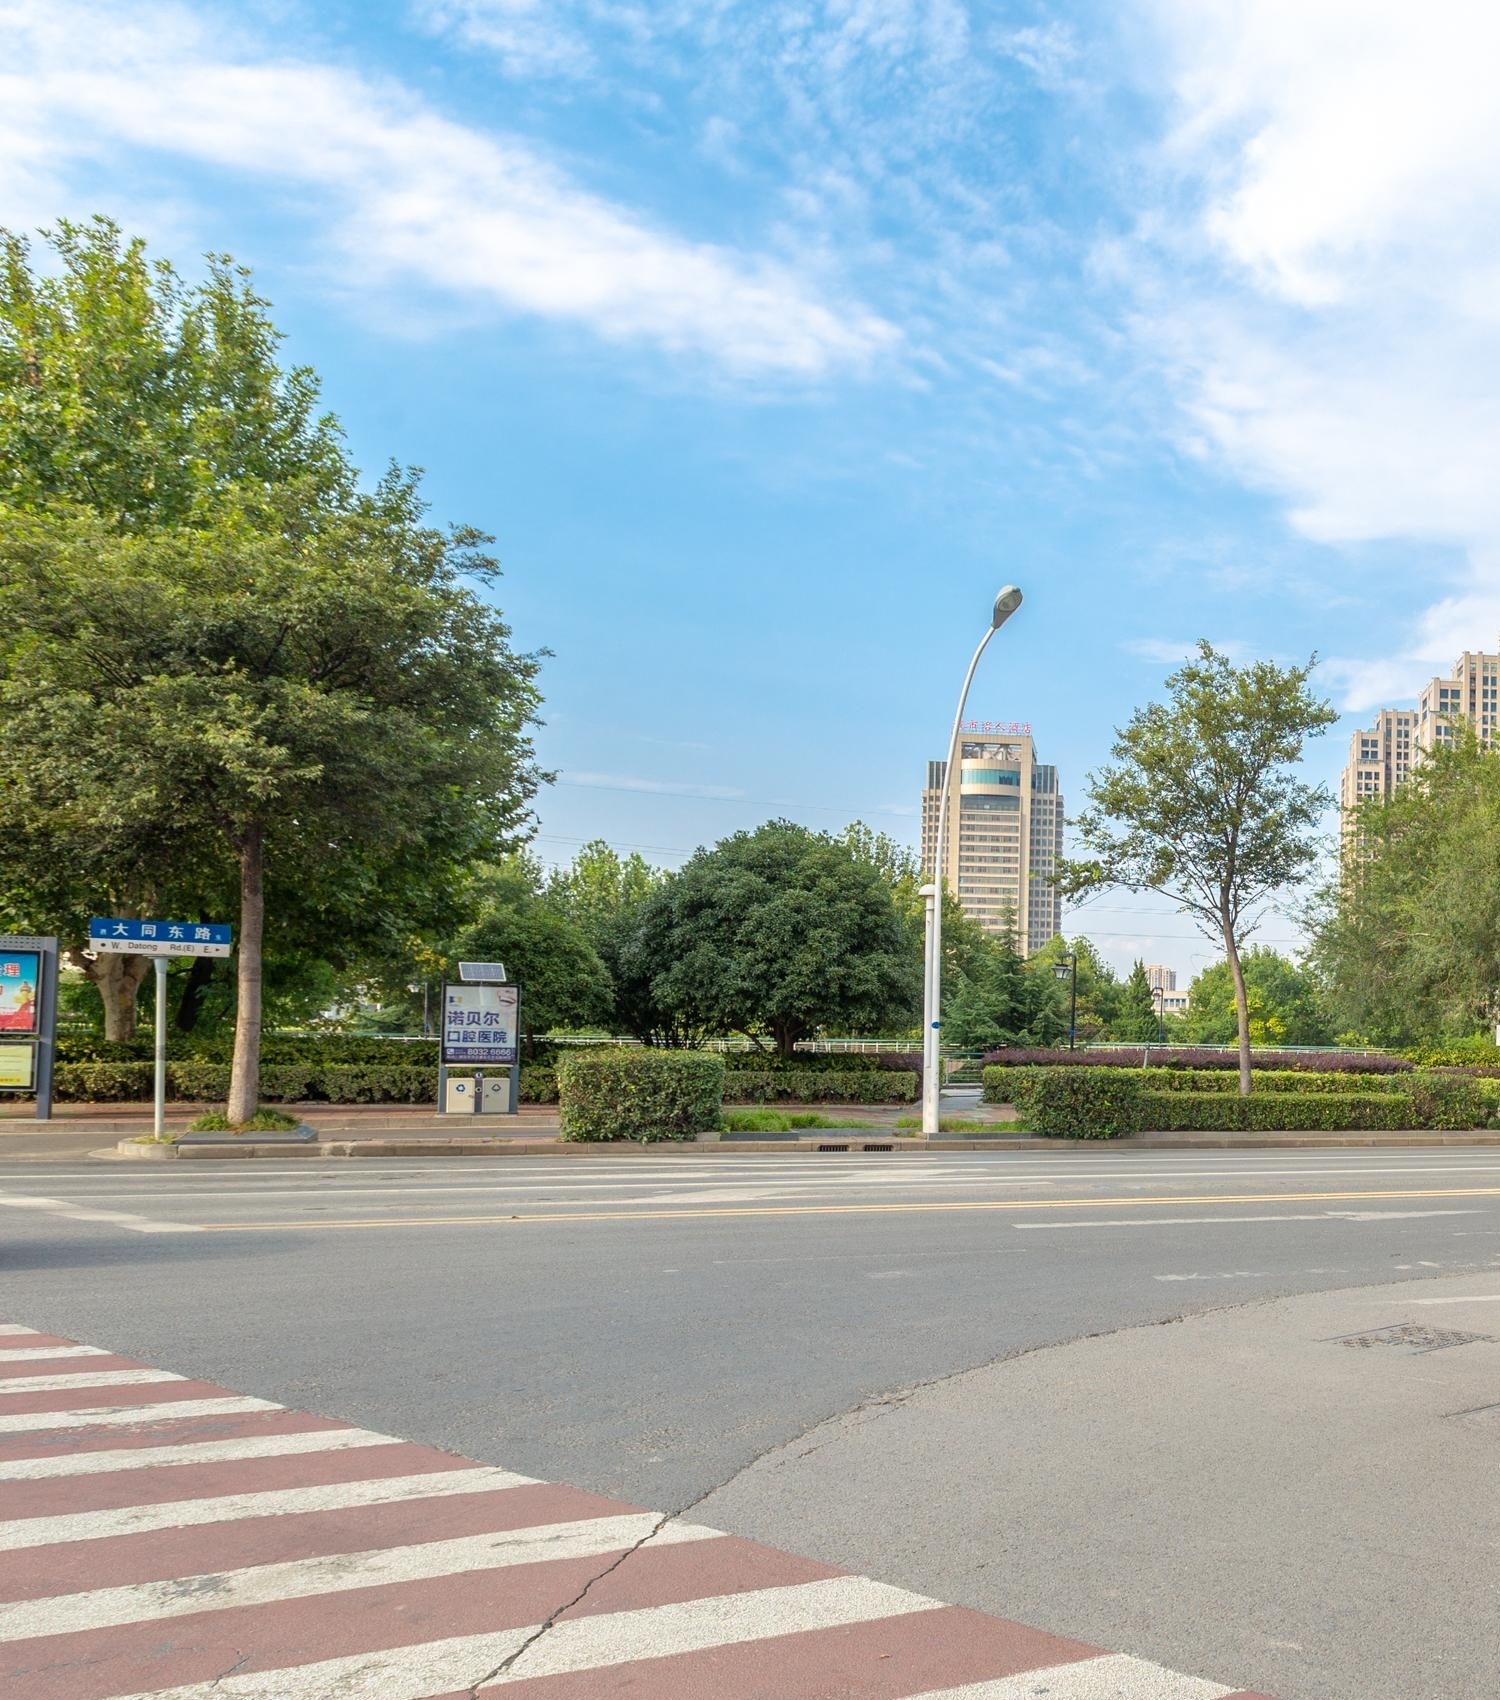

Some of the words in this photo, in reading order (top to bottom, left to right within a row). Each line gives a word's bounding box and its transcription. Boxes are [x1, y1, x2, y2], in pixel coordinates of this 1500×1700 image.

[112, 922, 211, 940] 大同东路
[128, 942, 158, 951] Datong
[448, 1011, 499, 1026] 诺贝尔
[447, 1030, 508, 1044] 口腔医院
